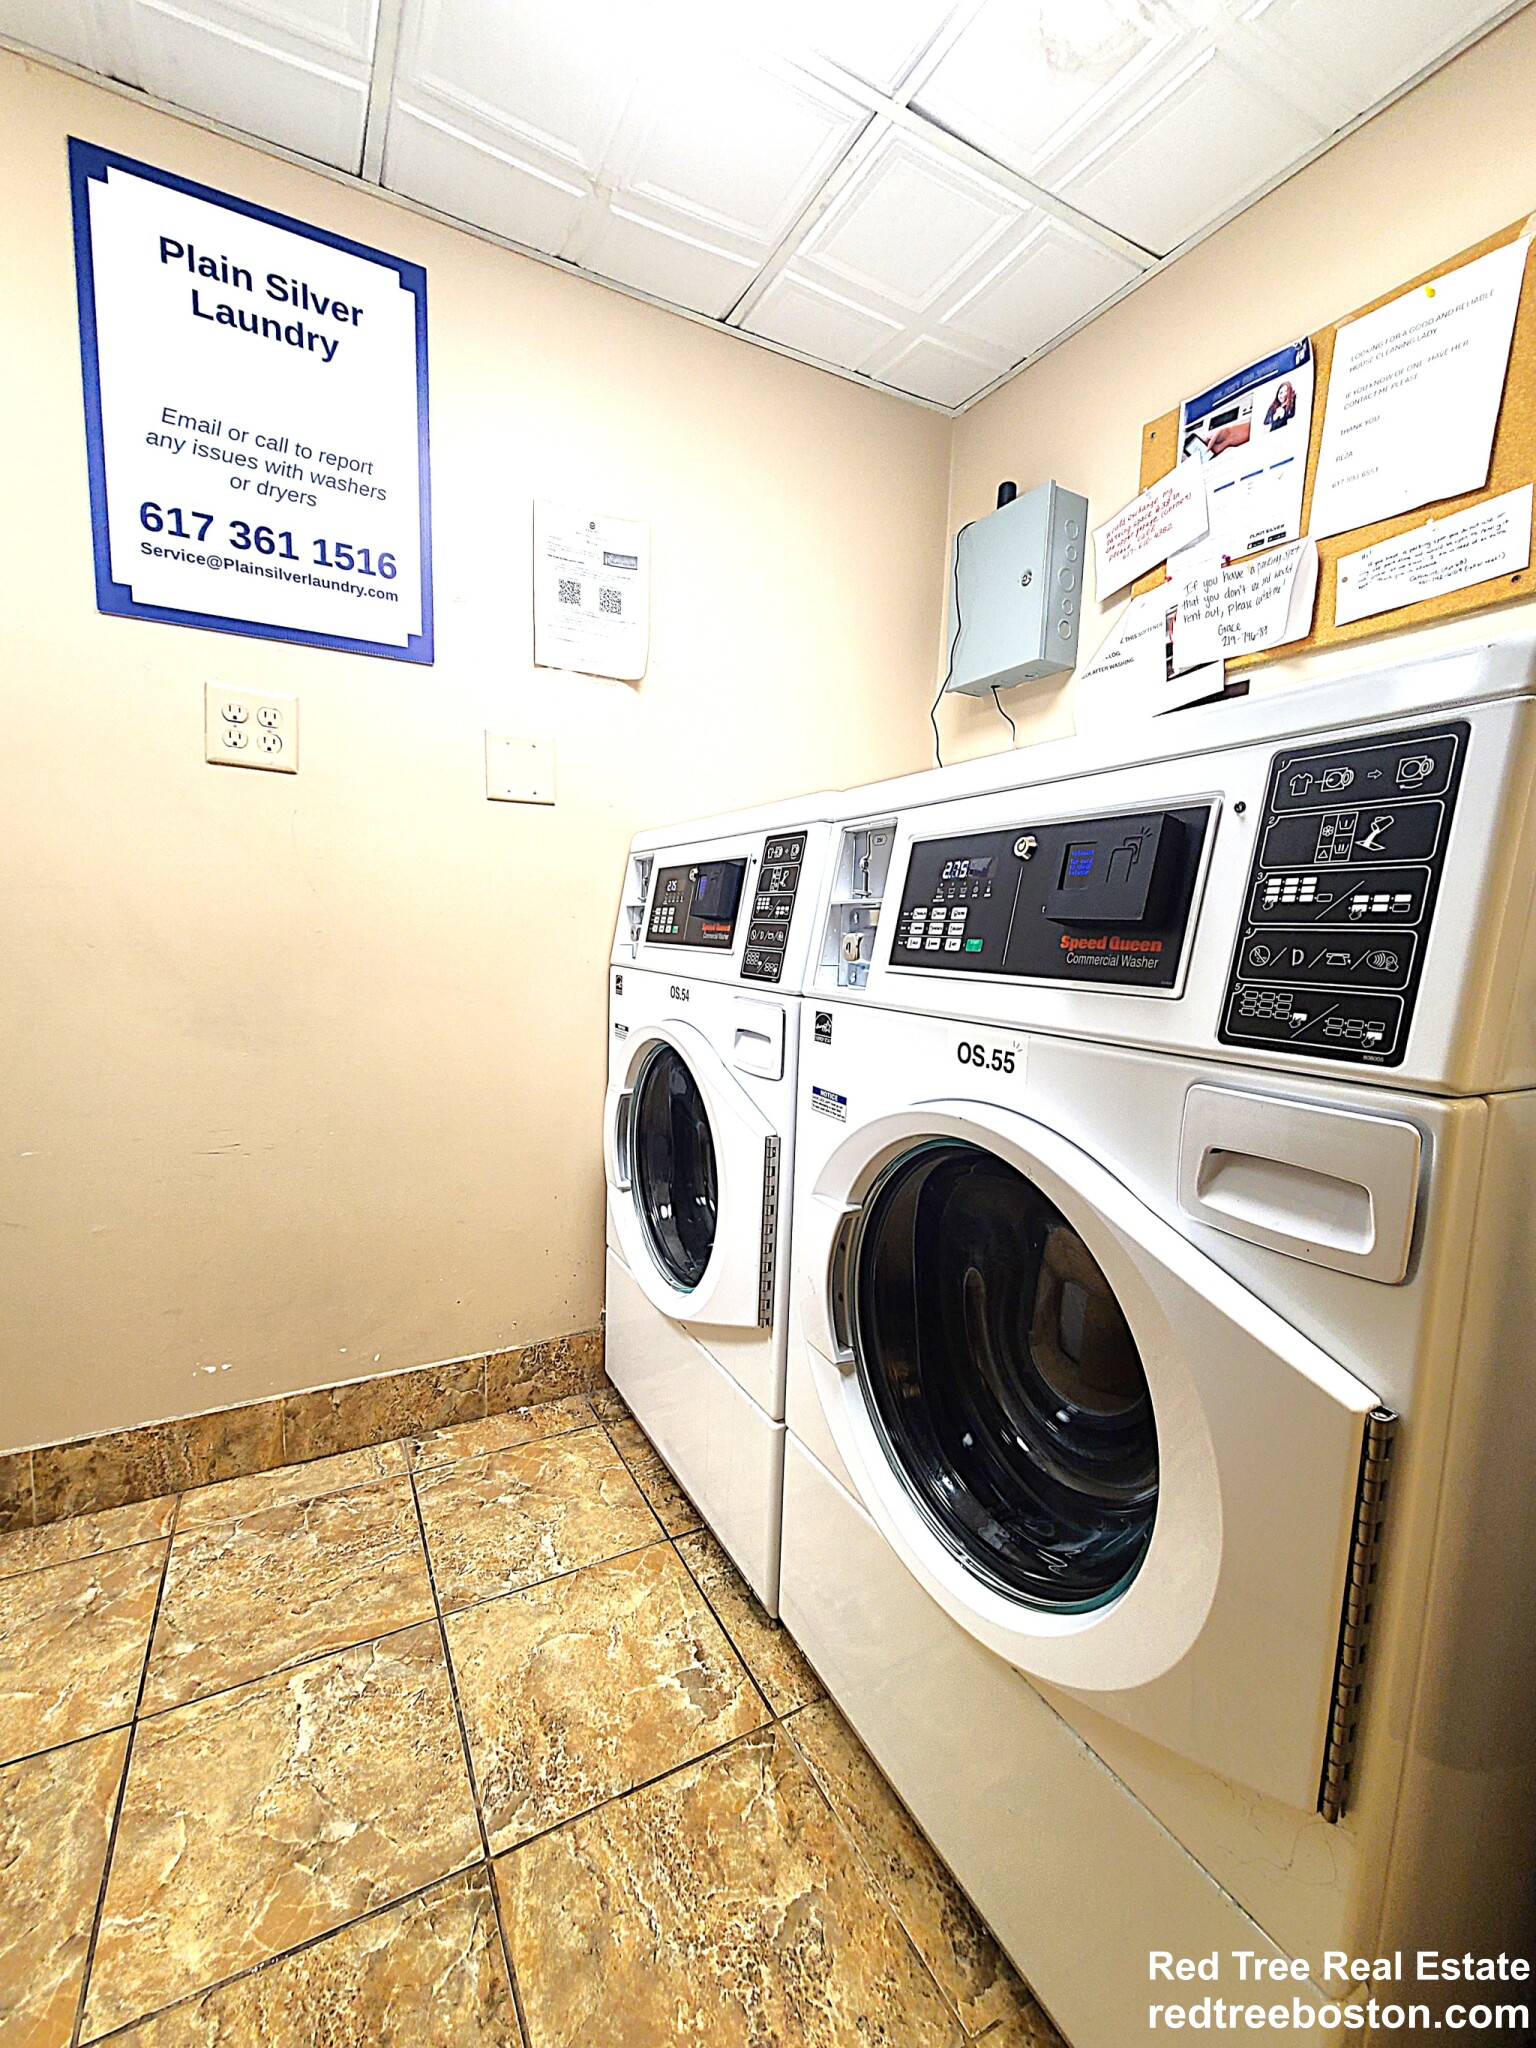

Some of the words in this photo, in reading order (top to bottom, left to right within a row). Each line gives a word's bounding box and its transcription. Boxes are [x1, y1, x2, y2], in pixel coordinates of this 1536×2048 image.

[158, 236, 253, 292] Plain
[265, 273, 364, 327] Silver
[192, 290, 339, 363] Laundry
[1350, 340, 1384, 362] LOOKING
[1385, 332, 1401, 345] FOR
[1408, 318, 1435, 334] GOOD
[1436, 308, 1454, 322] AND
[1455, 288, 1495, 312] RELIABLE
[1349, 356, 1374, 374] HOUSE
[1375, 337, 1416, 361] CLEANING
[1416, 328, 1438, 342] LADY
[1345, 392, 1352, 400] IF
[1353, 384, 1368, 396] YOU
[1368, 372, 1394, 389] KNOW
[1394, 368, 1405, 378] OF
[1427, 348, 1449, 363] HAVE
[1450, 339, 1469, 353] HER
[1343, 390, 1378, 411] CONTACT
[1378, 386, 1389, 395] ME
[1390, 373, 1419, 390] PLEASE
[1340, 422, 1363, 436] THANK
[161, 406, 222, 438] Email
[228, 424, 250, 444] or
[255, 428, 289, 456] call
[294, 442, 313, 460] to
[318, 447, 374, 478] report
[146, 428, 187, 458] any
[192, 438, 258, 470] issues
[264, 456, 304, 482] with
[310, 468, 388, 502] washers
[1336, 450, 1353, 462] REZA
[230, 474, 251, 492] or
[255, 478, 318, 511] dryers
[1332, 478, 1345, 488] 617
[139, 501, 214, 542] 617
[229, 520, 300, 561] 361
[312, 538, 398, 580] 1516
[140, 542, 399, 603] Service@Plainsilverlaundry.com
[1184, 580, 1198, 596] If
[1203, 577, 1218, 594] you
[1222, 569, 1244, 583] have
[1250, 566, 1256, 575] a
[1257, 554, 1282, 576] parking
[1182, 596, 1199, 610] that
[1203, 593, 1220, 609] you
[1224, 584, 1247, 599] don't
[1274, 563, 1293, 579] would
[1184, 610, 1201, 623] rent
[1204, 606, 1224, 619] out,
[1125, 634, 1137, 643] THIS
[1218, 622, 1241, 636] Grace
[1092, 666, 1109, 675] AFTER
[1109, 657, 1135, 670] WASHING
[1268, 816, 1276, 824] 2
[1257, 872, 1264, 880] 3
[1060, 934, 1108, 952] Speed
[1109, 938, 1163, 952] Queen
[1066, 952, 1118, 967] Commercial
[1120, 955, 1159, 969] Washer
[670, 985, 690, 1002] OS.54
[1234, 983, 1241, 991] 5
[957, 1042, 1015, 1074] OS.55
[820, 1090, 838, 1100] NOTICE
